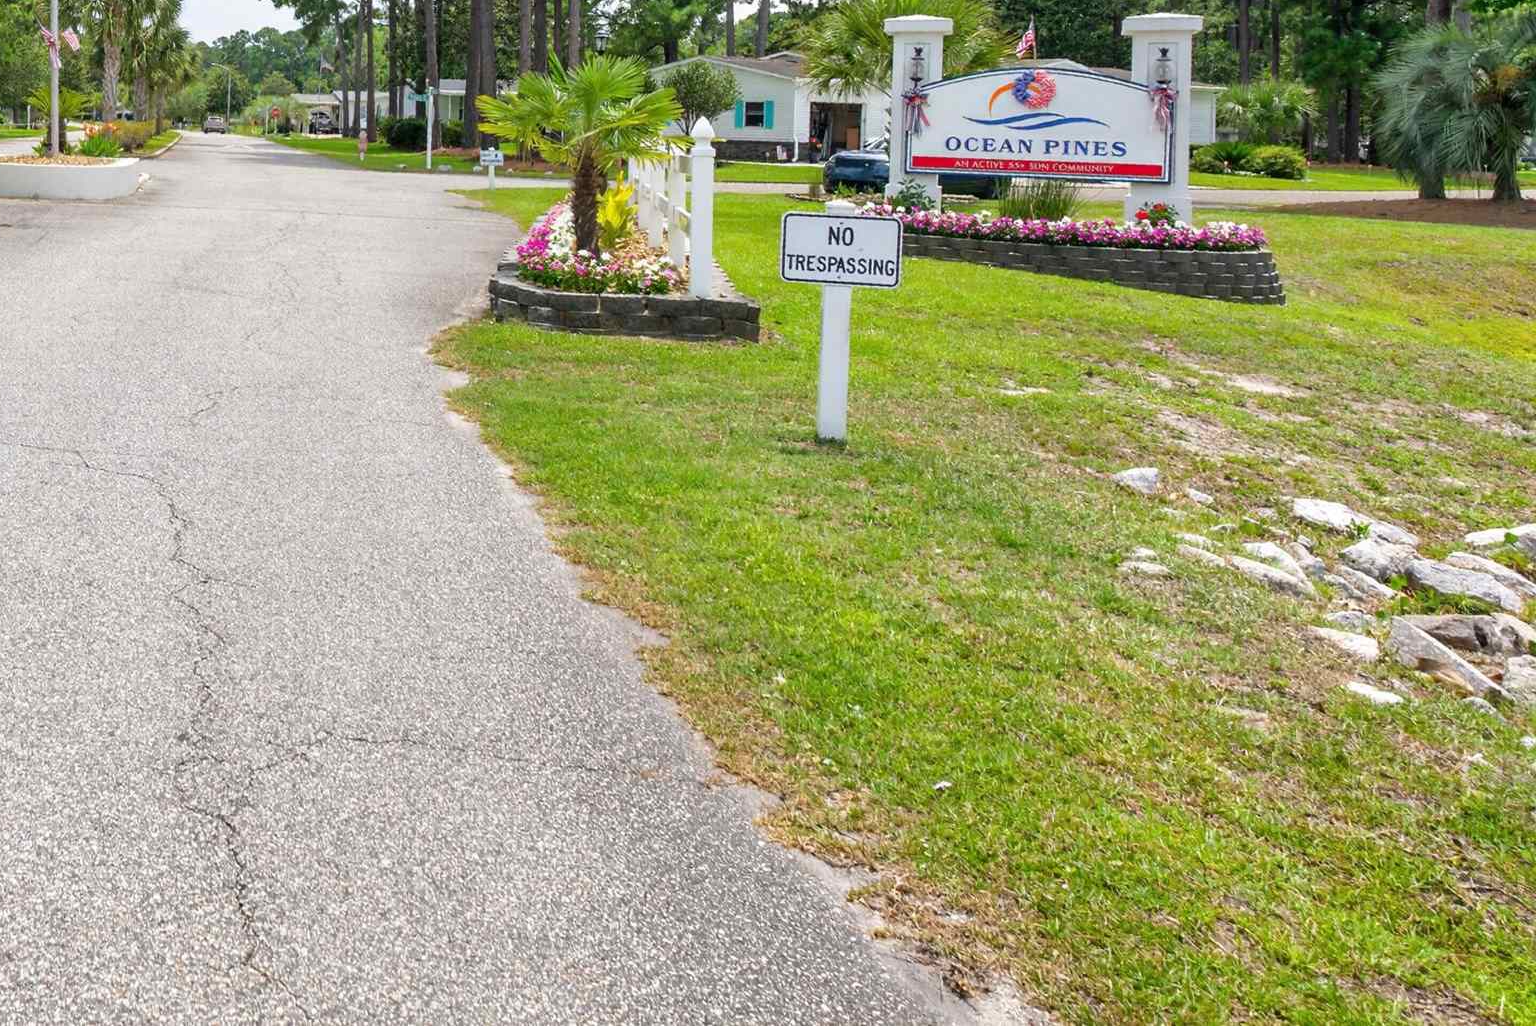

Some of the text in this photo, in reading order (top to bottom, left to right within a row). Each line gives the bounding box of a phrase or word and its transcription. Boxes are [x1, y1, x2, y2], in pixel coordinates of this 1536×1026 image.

[945, 136, 1128, 157] OCEAN PINES
[954, 159, 1114, 173] AN ACTIVE 55+ SUN COMMUNITY
[828, 226, 855, 246] NO
[786, 254, 895, 276] TRESPASSING
